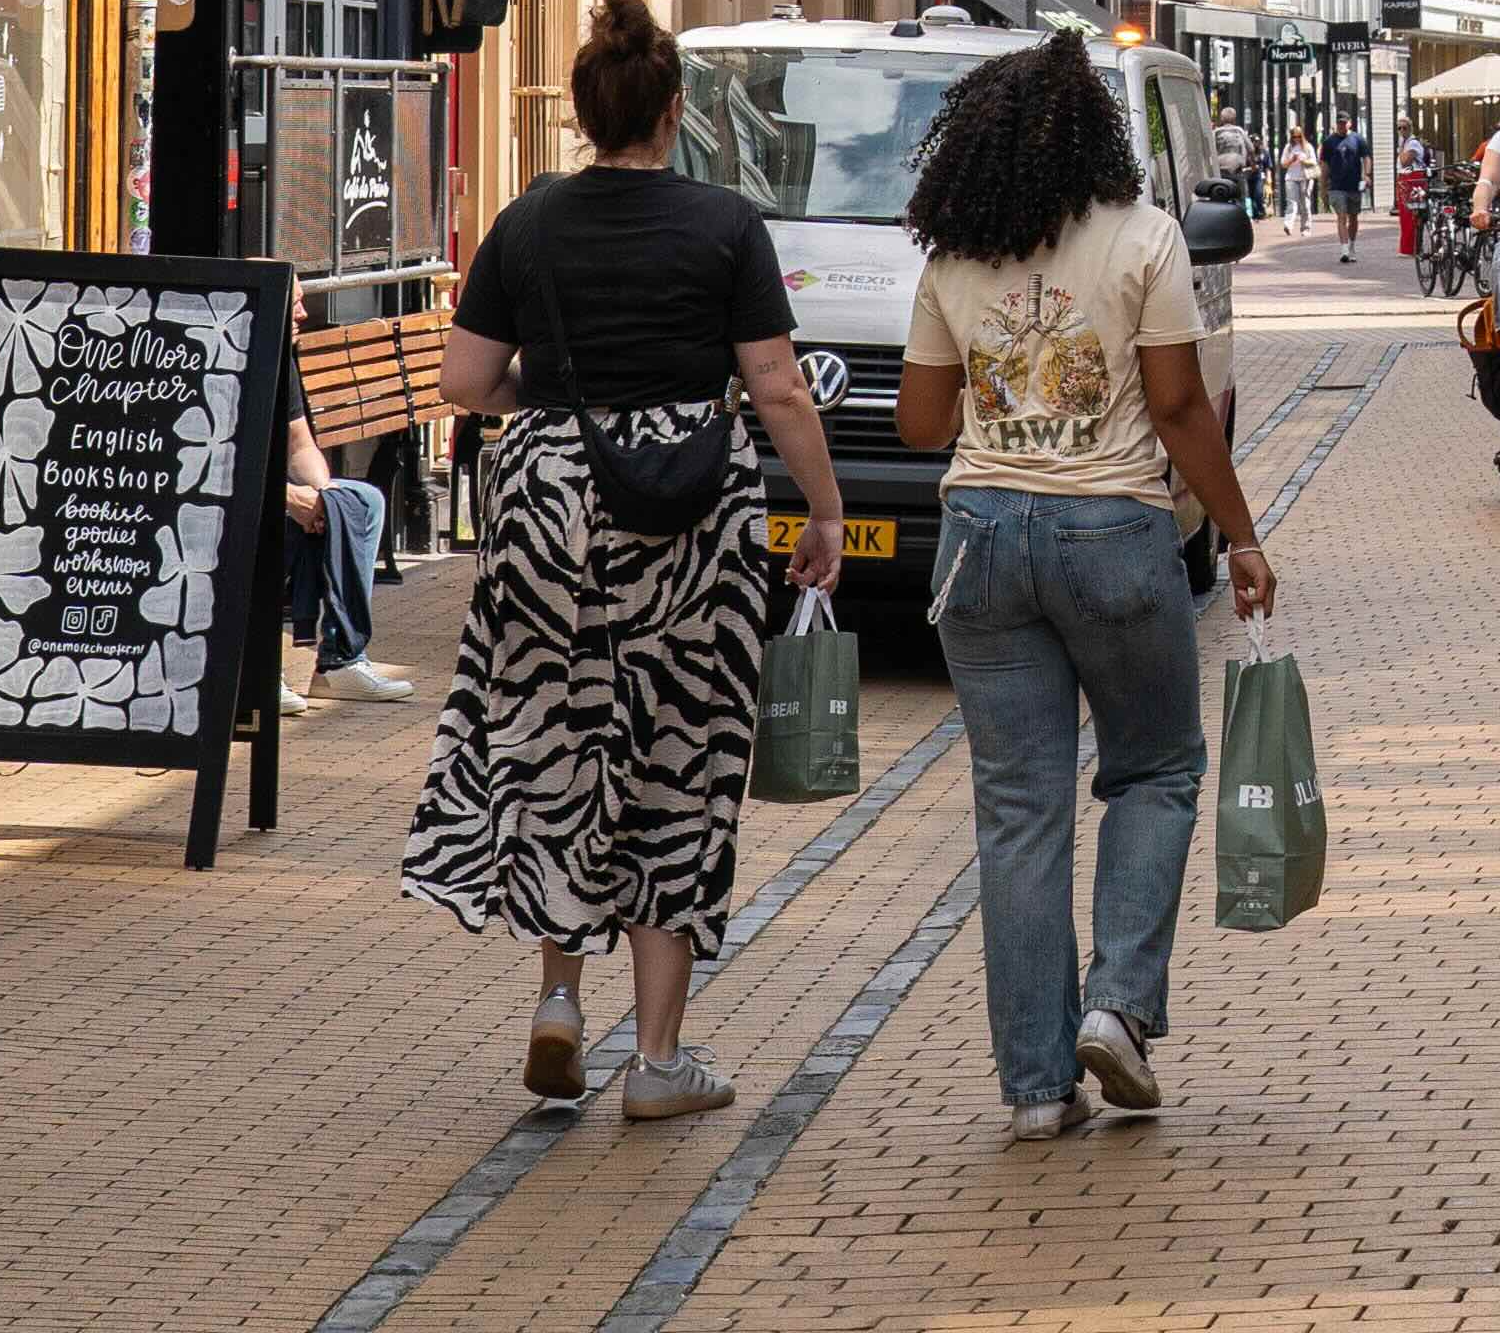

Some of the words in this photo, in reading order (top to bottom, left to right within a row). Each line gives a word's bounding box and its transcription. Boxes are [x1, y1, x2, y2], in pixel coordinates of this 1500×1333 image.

[1271, 49, 1307, 60] Normal
[827, 273, 896, 286] ENEXIS
[58, 324, 124, 371] One
[130, 326, 201, 371] More
[50, 372, 197, 415] Chapter
[70, 424, 164, 457] English
[54, 493, 154, 523] bookish
[64, 526, 137, 551] goodies
[53, 547, 152, 579] workshops
[66, 577, 133, 598] events
